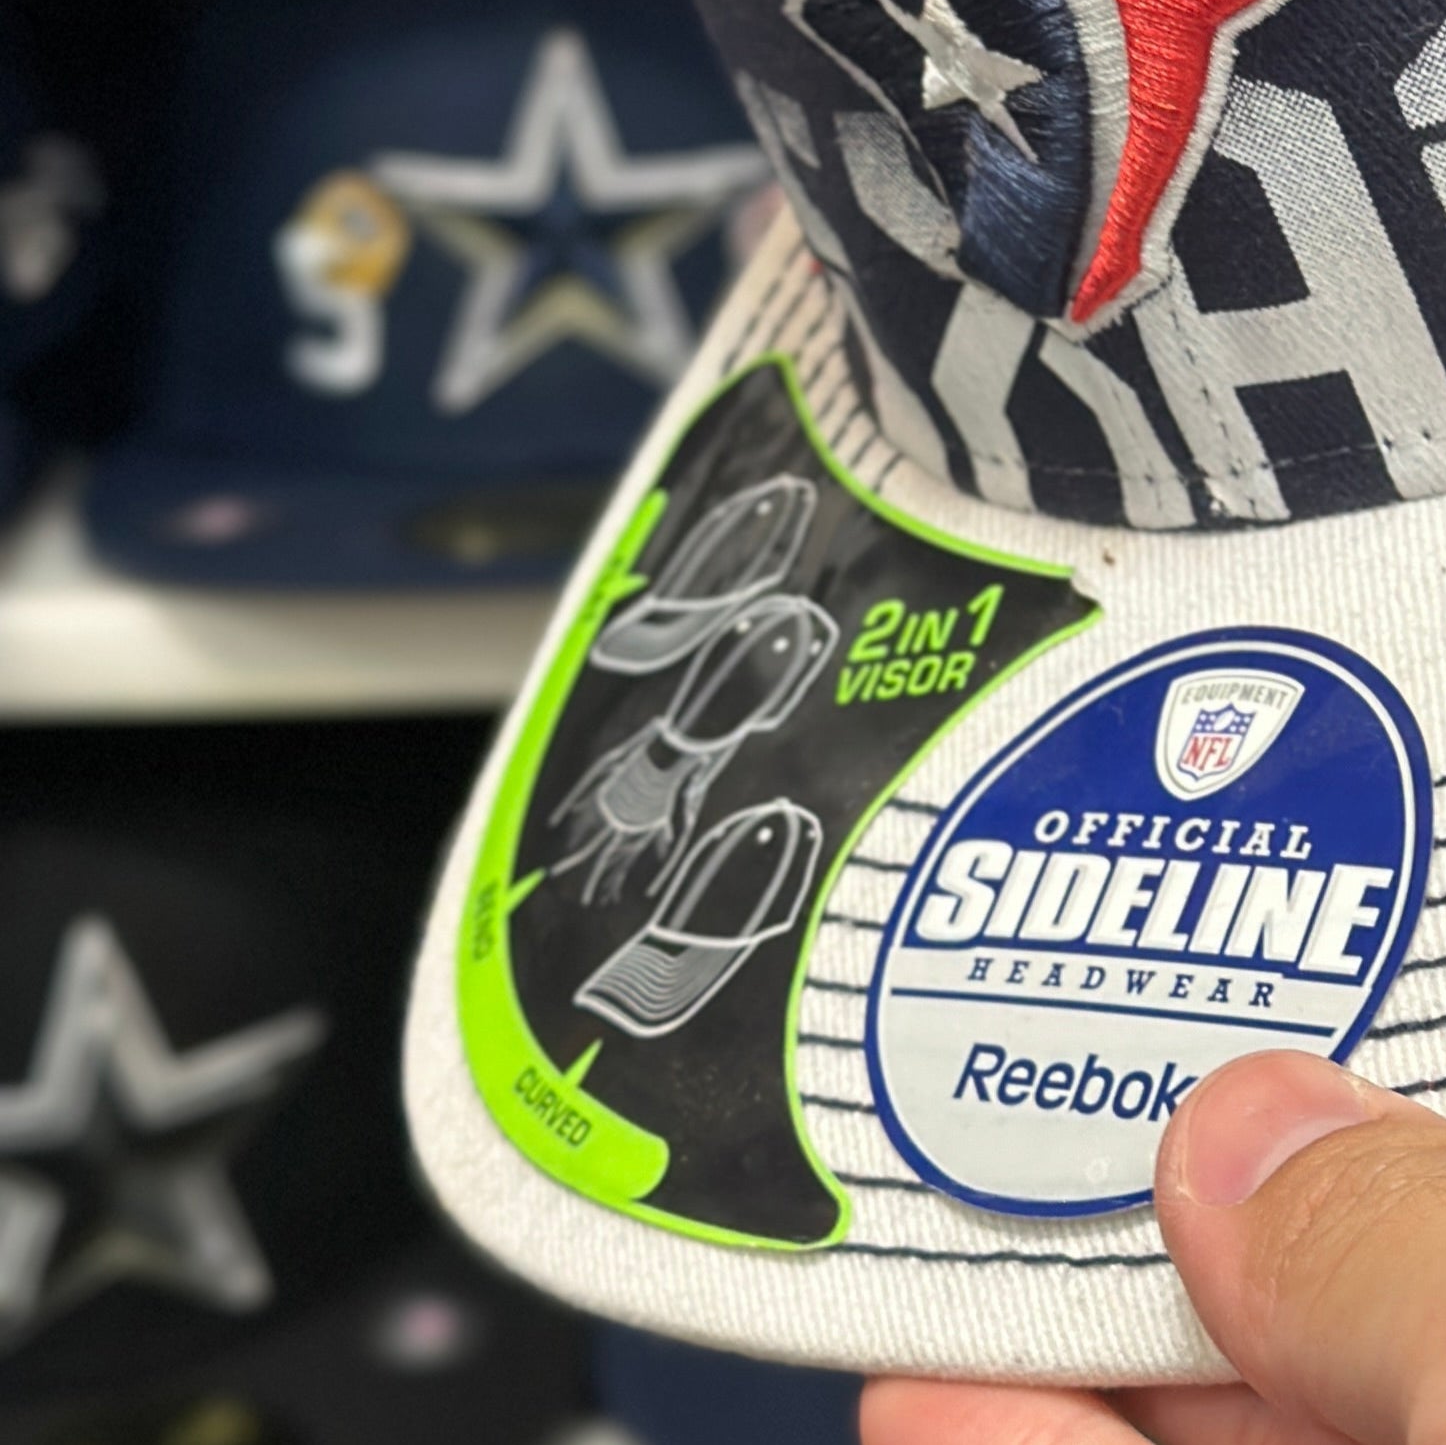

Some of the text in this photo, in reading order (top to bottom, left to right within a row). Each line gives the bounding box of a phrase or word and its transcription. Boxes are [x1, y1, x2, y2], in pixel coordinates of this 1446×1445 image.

[835, 651, 976, 706] VISOR
[1181, 682, 1289, 710] EQUIPMENT
[1182, 735, 1234, 772] NFL
[1034, 809, 1314, 859] OFFICIAL
[915, 839, 1395, 976] SIDELINE
[967, 957, 1275, 1008] HEADWEAR
[513, 1066, 592, 1147] CURVED
[952, 1043, 1200, 1123] Reebok
